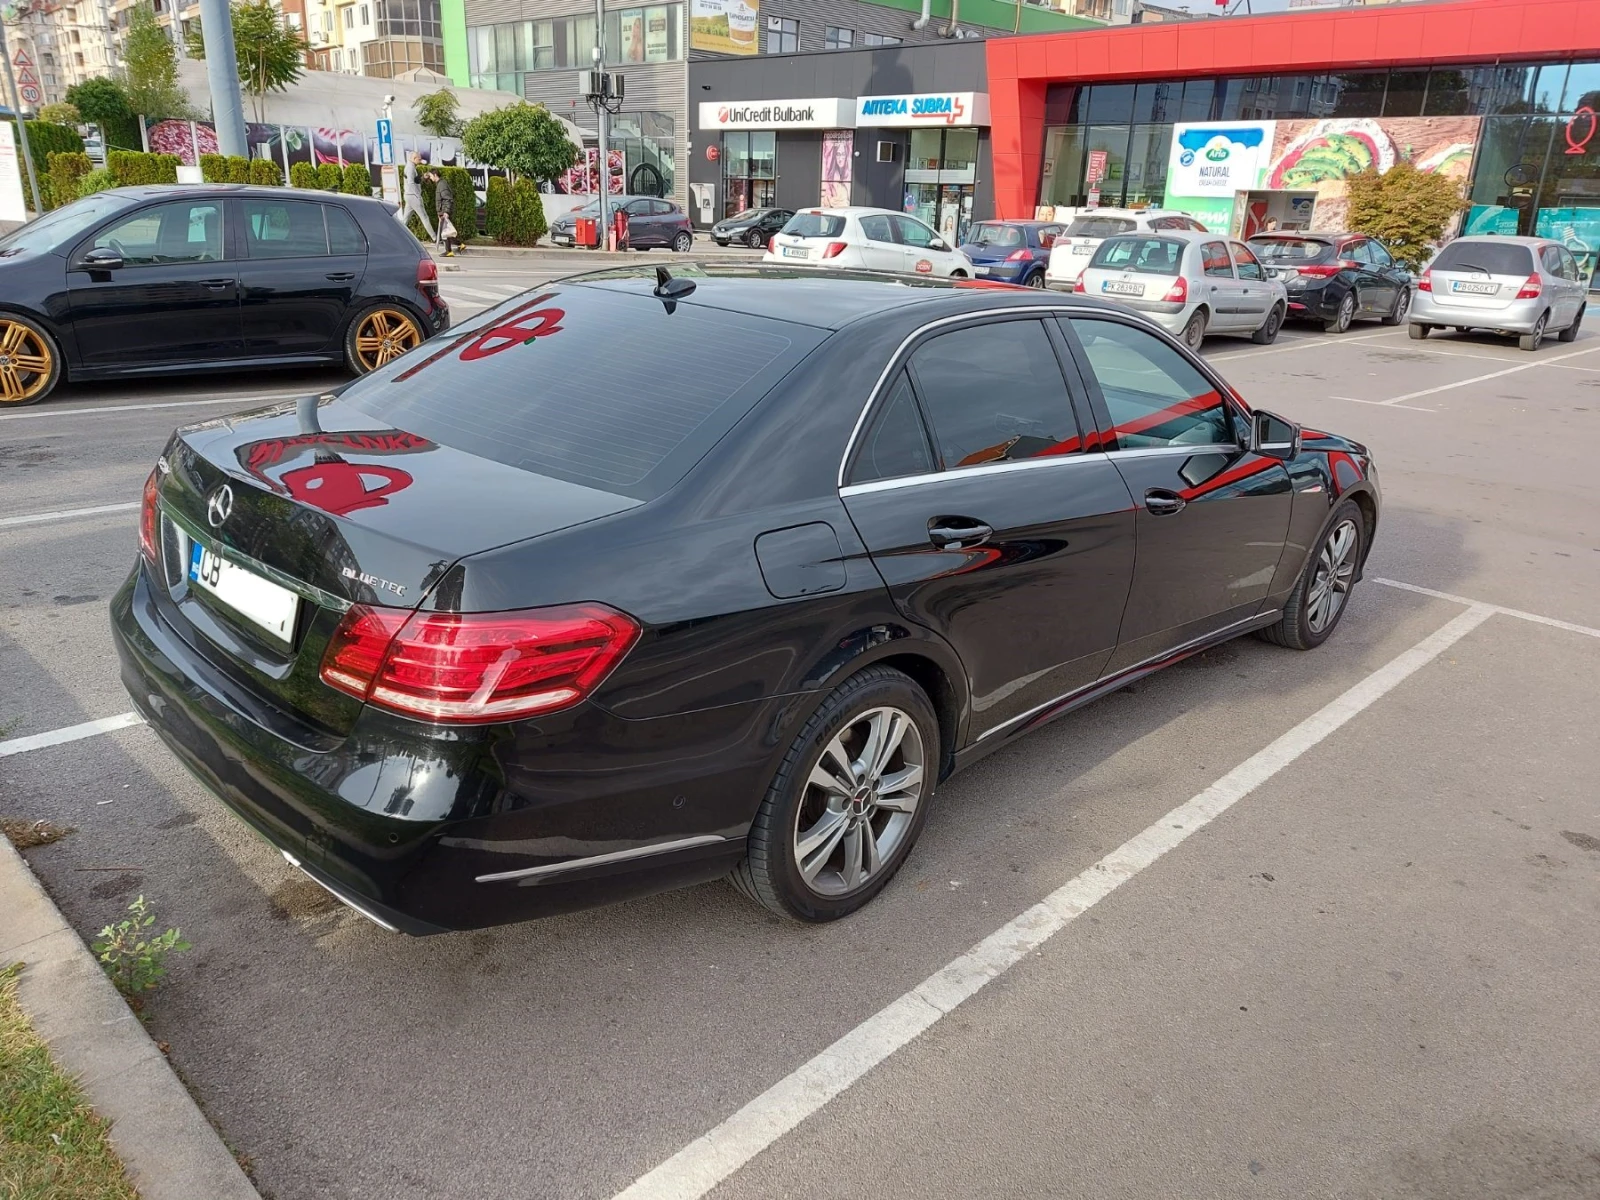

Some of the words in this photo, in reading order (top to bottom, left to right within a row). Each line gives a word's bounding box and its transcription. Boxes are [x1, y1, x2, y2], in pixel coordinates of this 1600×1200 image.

[24, 89, 37, 99] 30
[912, 97, 951, 114] SUBRA
[729, 107, 771, 122] UniCredit
[773, 106, 814, 122] Bulbank
[380, 121, 388, 143] P
[1208, 149, 1226, 158] Arla
[1199, 166, 1231, 178] NATURAL
[342, 566, 407, 598] BLUETEC
